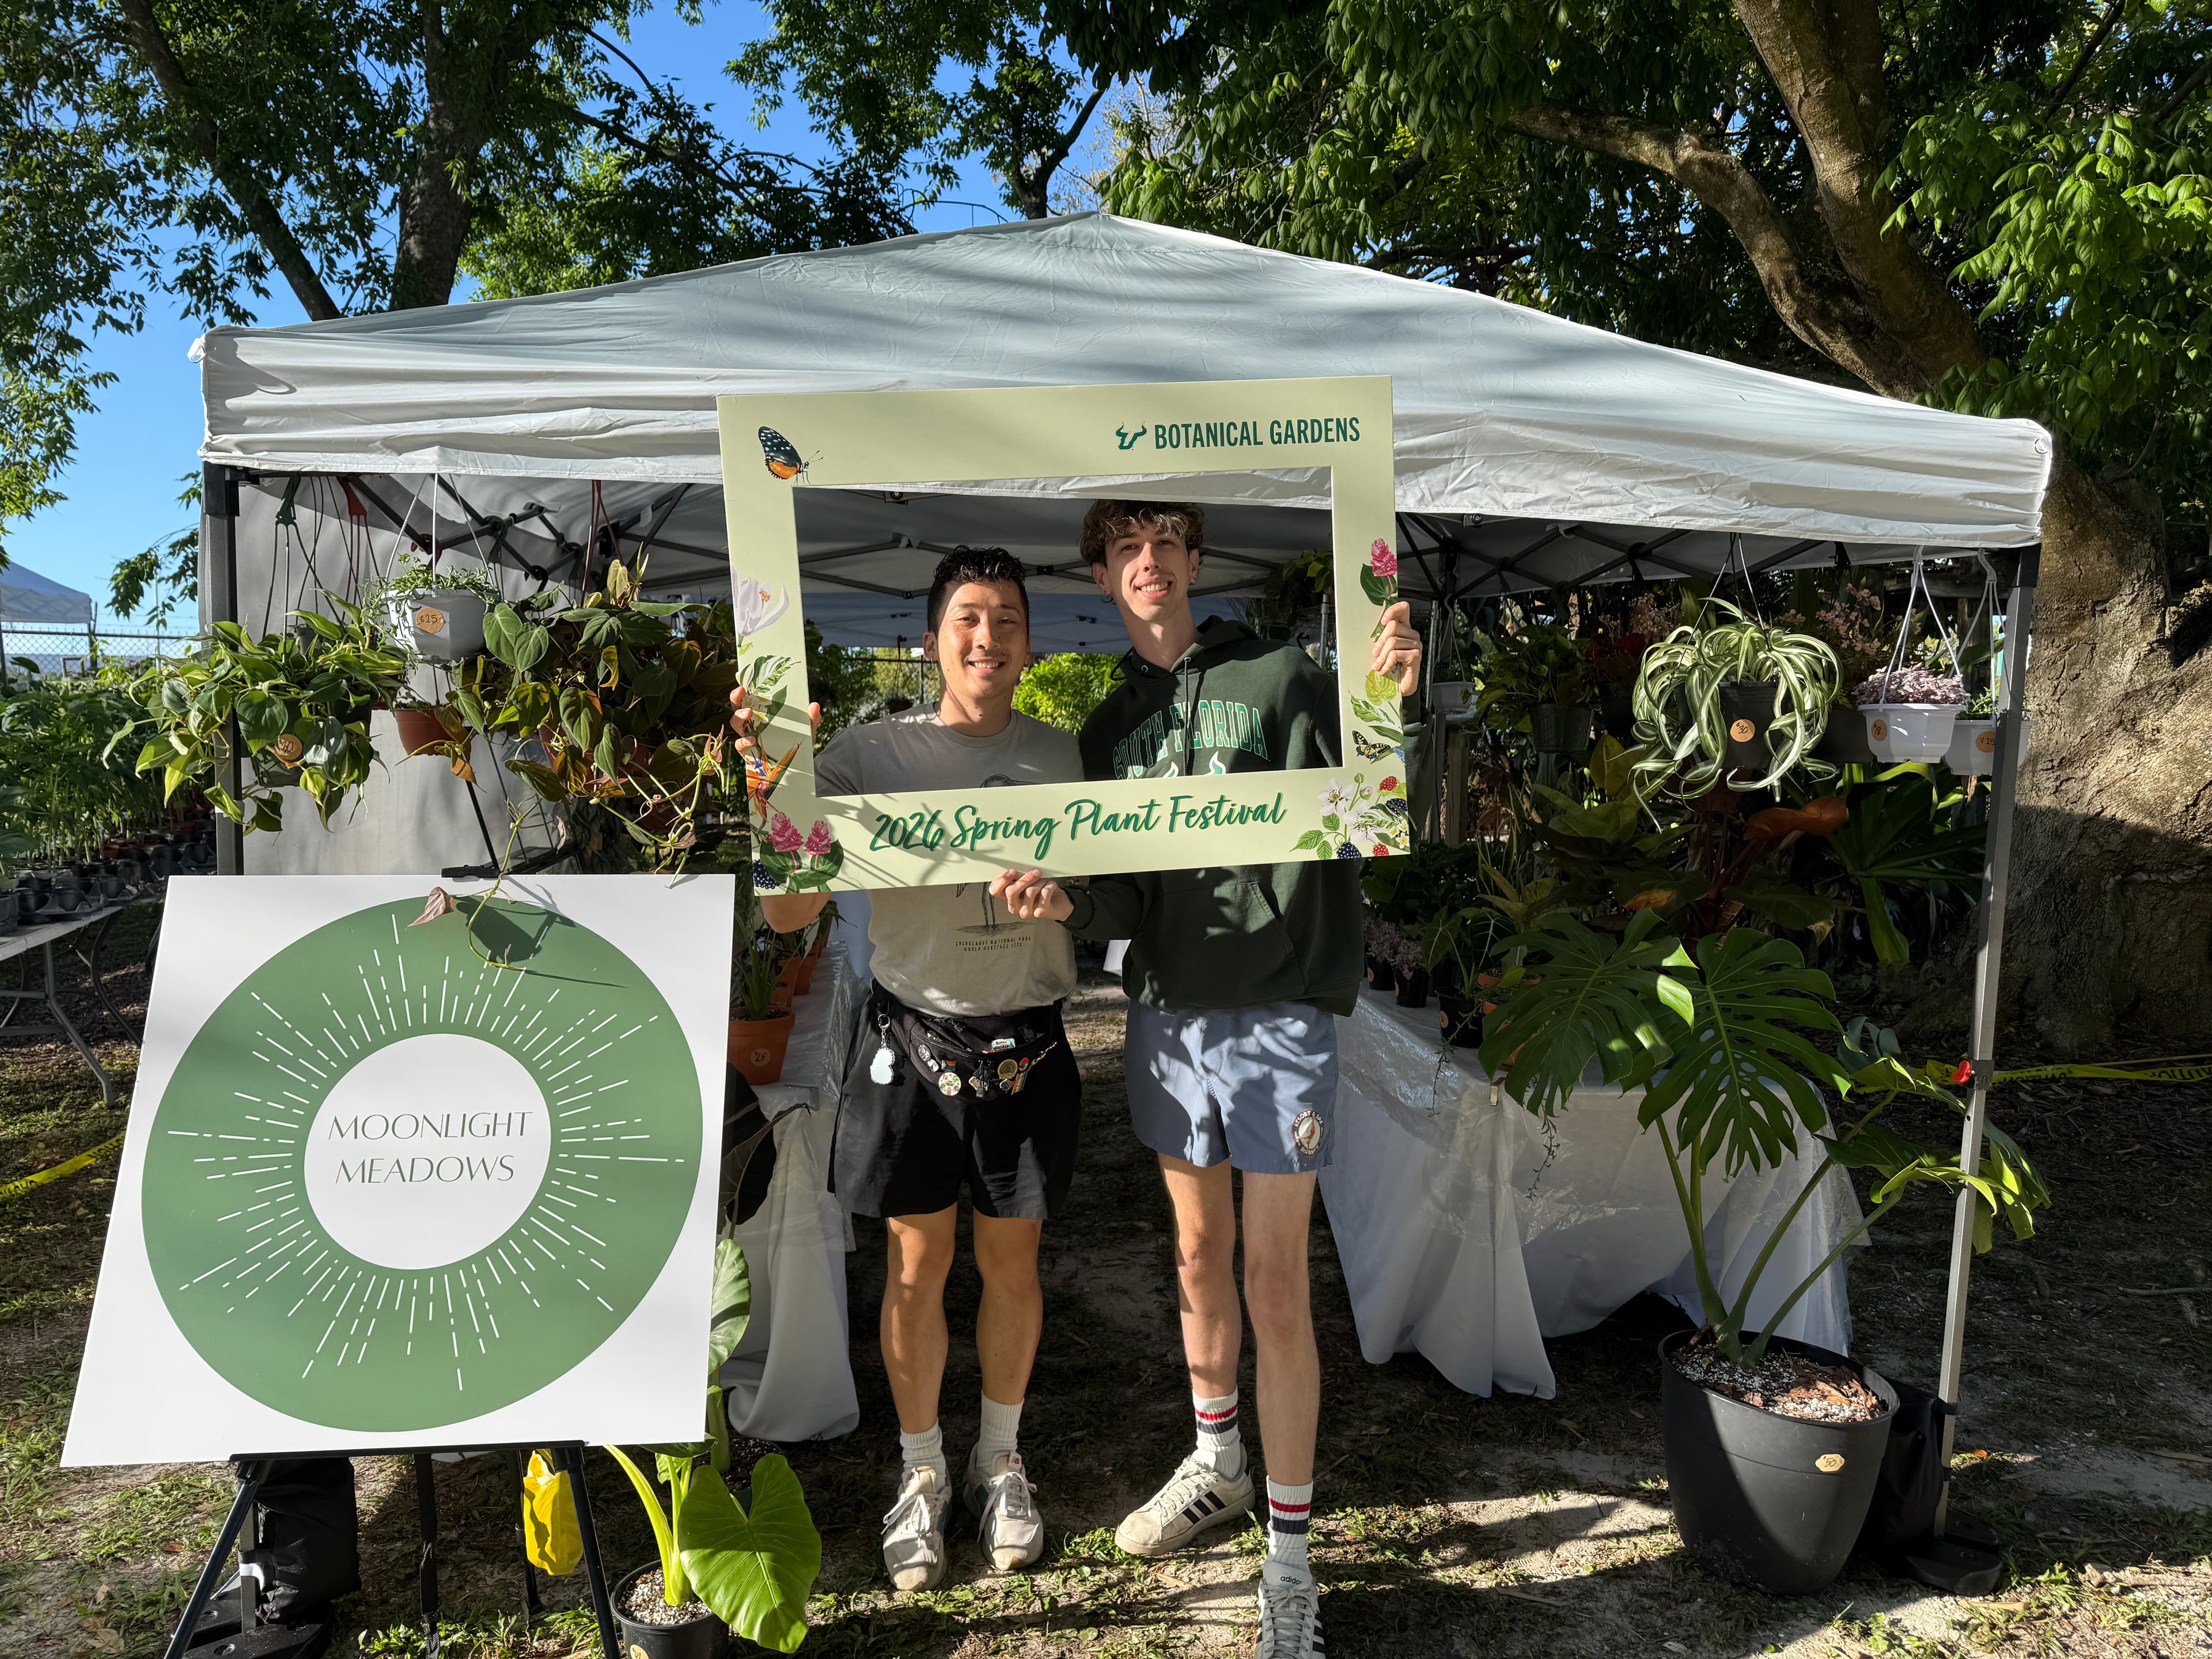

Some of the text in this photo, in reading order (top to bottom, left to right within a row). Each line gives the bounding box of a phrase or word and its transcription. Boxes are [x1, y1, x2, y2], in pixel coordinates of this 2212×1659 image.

[1154, 416, 1360, 449] BOTANICAL GARDENS
[1112, 700, 1268, 780] SOUTH FLORIDA
[870, 792, 1287, 861] 2026 Spring Plant Festival
[328, 1112, 533, 1140] MOONLIGHT
[335, 1155, 515, 1184] MEADOWS
